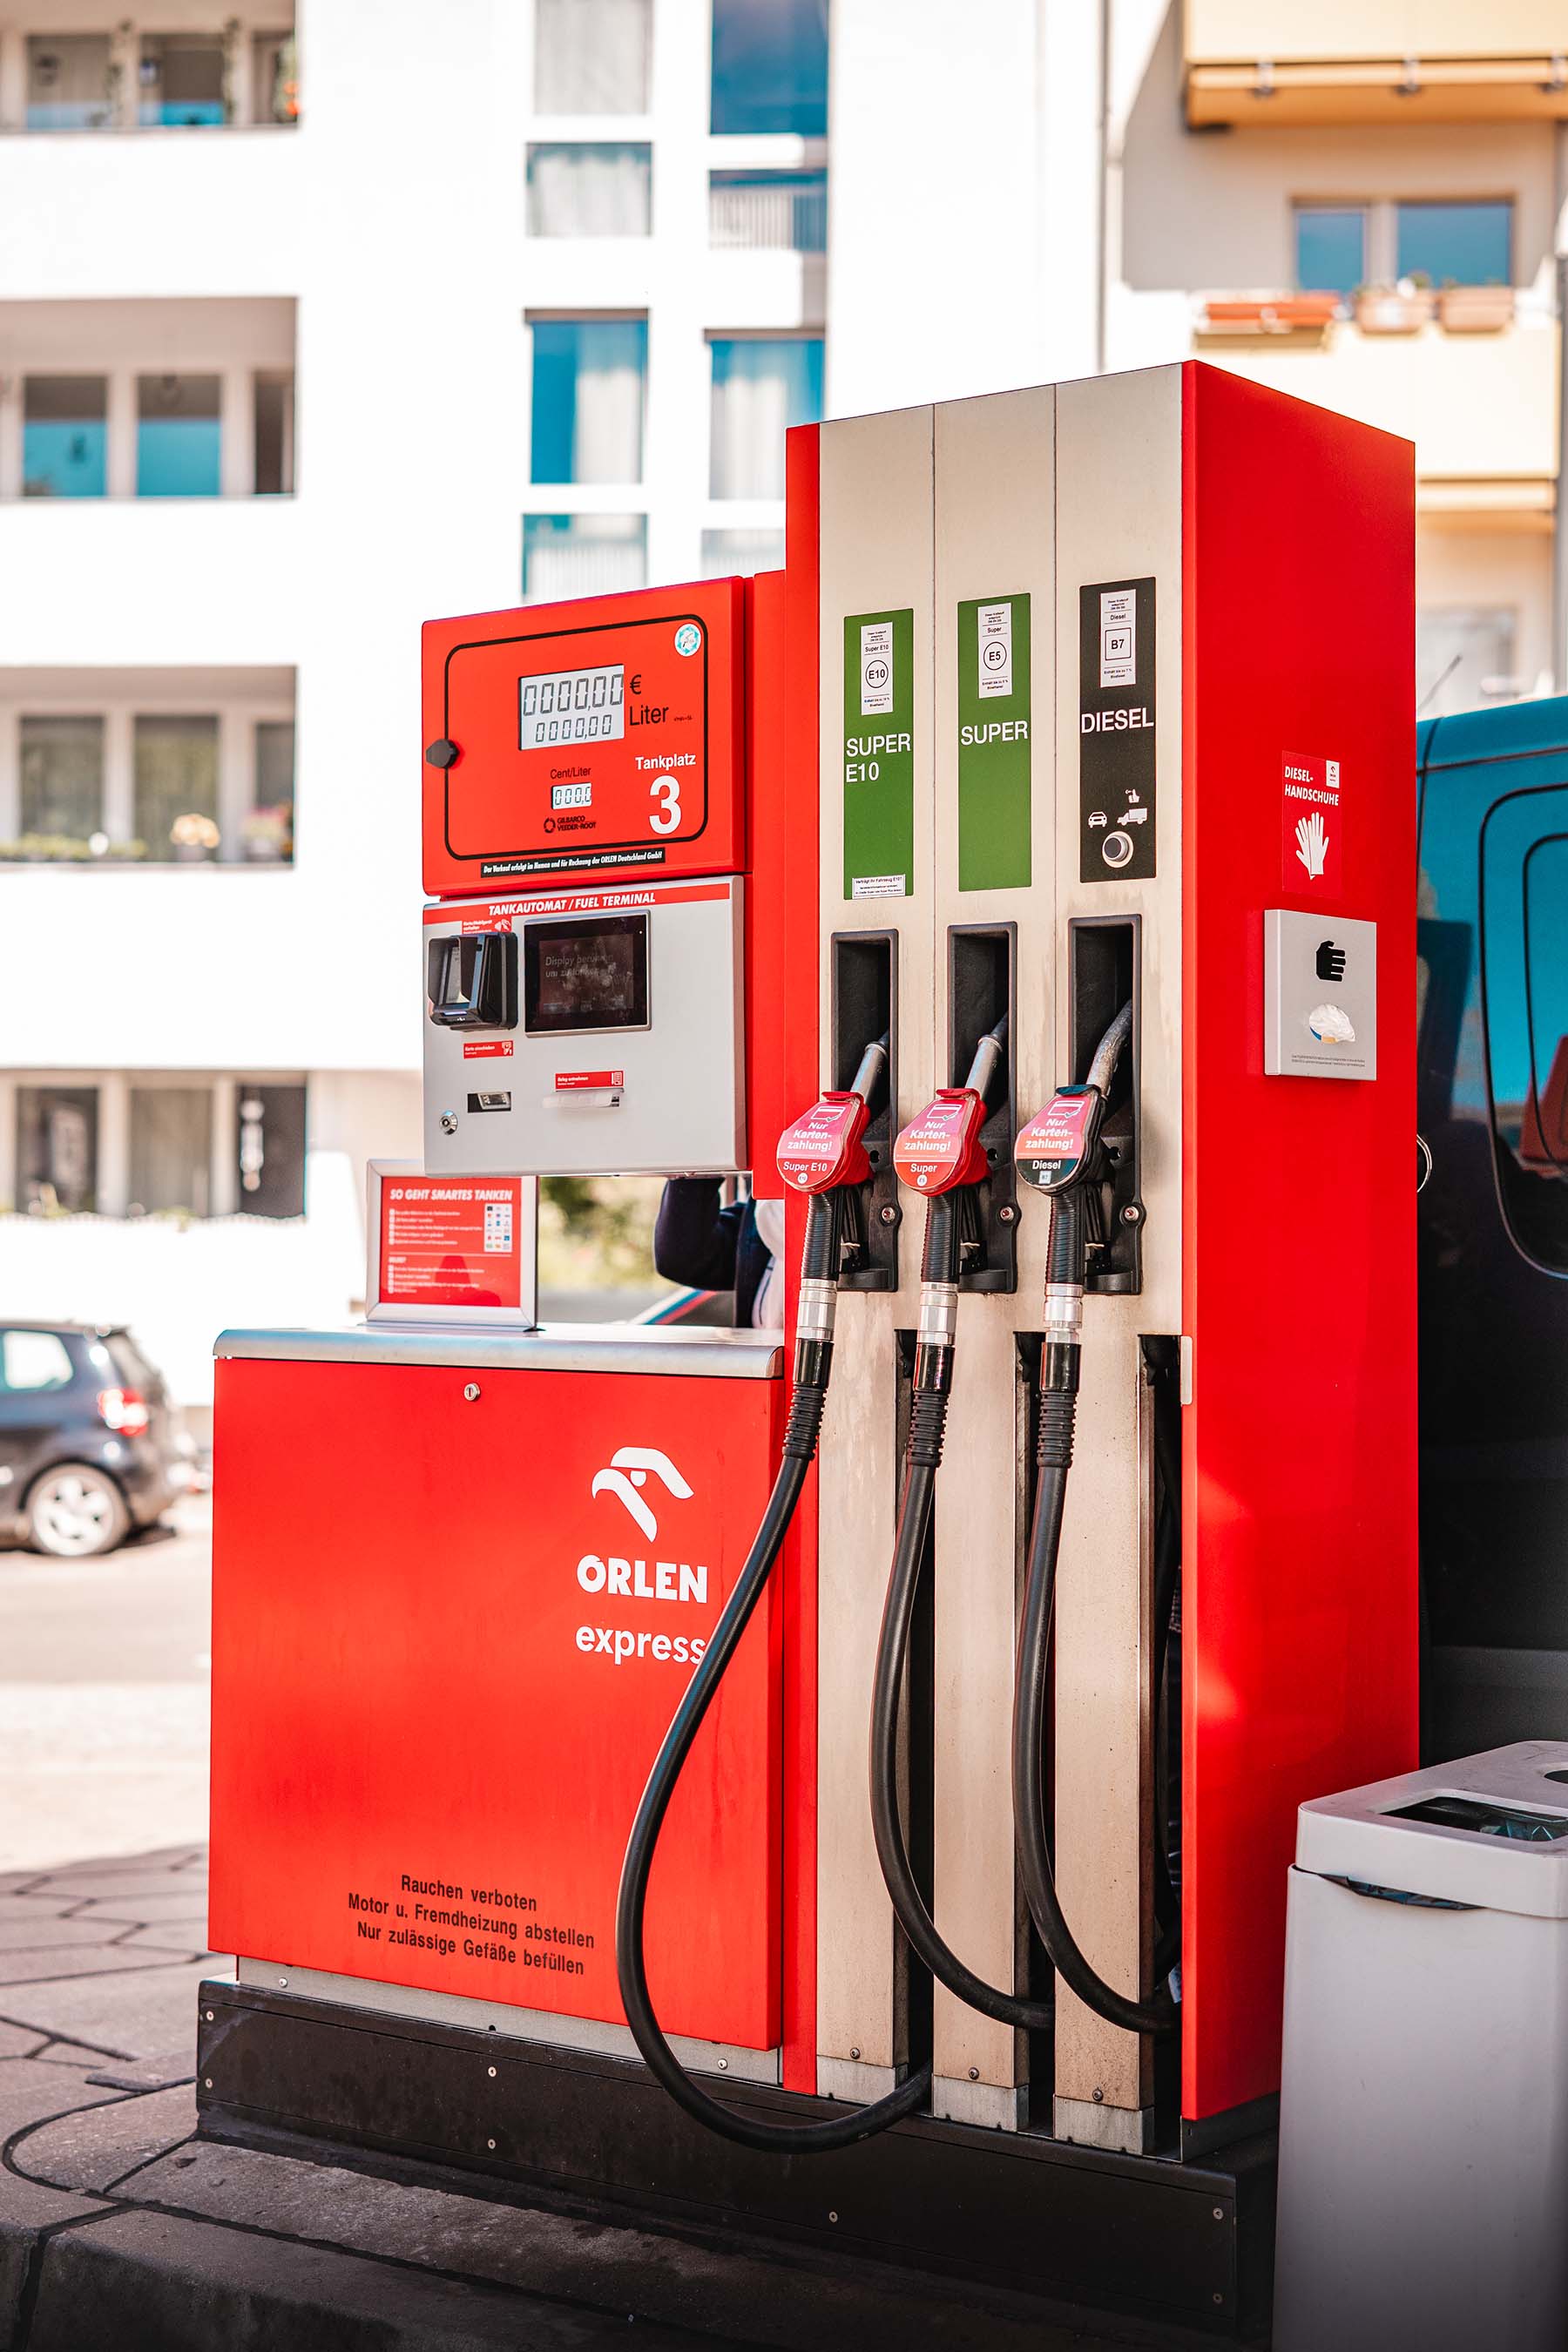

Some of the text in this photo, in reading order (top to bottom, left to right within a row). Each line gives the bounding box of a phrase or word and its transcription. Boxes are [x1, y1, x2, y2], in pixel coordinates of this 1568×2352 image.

[1111, 639, 1125, 650] B7
[989, 651, 1001, 661] E5
[868, 669, 885, 679] E10
[630, 674, 642, 695] €
[630, 705, 669, 726] Liter
[1081, 707, 1154, 733] DIESEL
[961, 720, 1029, 746] SUPER
[846, 733, 911, 757] SUPER
[635, 753, 696, 771] Tankplatz
[551, 767, 591, 779] Cent/Liter
[846, 761, 880, 782] E10
[1285, 784, 1339, 806] HANDSCHUHE
[649, 774, 682, 835] 3
[483, 865, 492, 874] Der
[492, 864, 510, 873] Verkauf
[510, 862, 526, 872] erfolgt
[568, 857, 591, 868] Rechnung
[591, 856, 600, 865] der
[600, 855, 618, 863] ORLEN
[618, 852, 646, 862] Deutschland
[647, 851, 663, 860] GmbH
[488, 899, 567, 916] TANKAUTOMAT
[575, 896, 599, 909] FUEL
[602, 892, 656, 907] TERMINAL
[545, 956, 573, 968] Display
[793, 1130, 832, 1139] Karten-
[909, 1130, 951, 1139] Karten-
[1031, 1127, 1073, 1137] Karten-
[787, 1140, 833, 1152] zahlung!
[904, 1141, 951, 1152] zahlung!
[1025, 1139, 1073, 1150] zahlung!
[783, 1161, 828, 1173] Super E10
[910, 1164, 937, 1174] Super
[1032, 1159, 1061, 1170] Diesel
[390, 1188, 513, 1201] SO GEHT SMARTES TANKEN
[577, 1554, 707, 1604] ORLEN
[576, 1625, 706, 1665] express
[401, 1875, 537, 1911] Rauchen verboten
[348, 1893, 595, 1949] Motor u. Fremdheizung abstellen
[357, 1921, 585, 1976] Nur zulässige Gefäße befüllen
